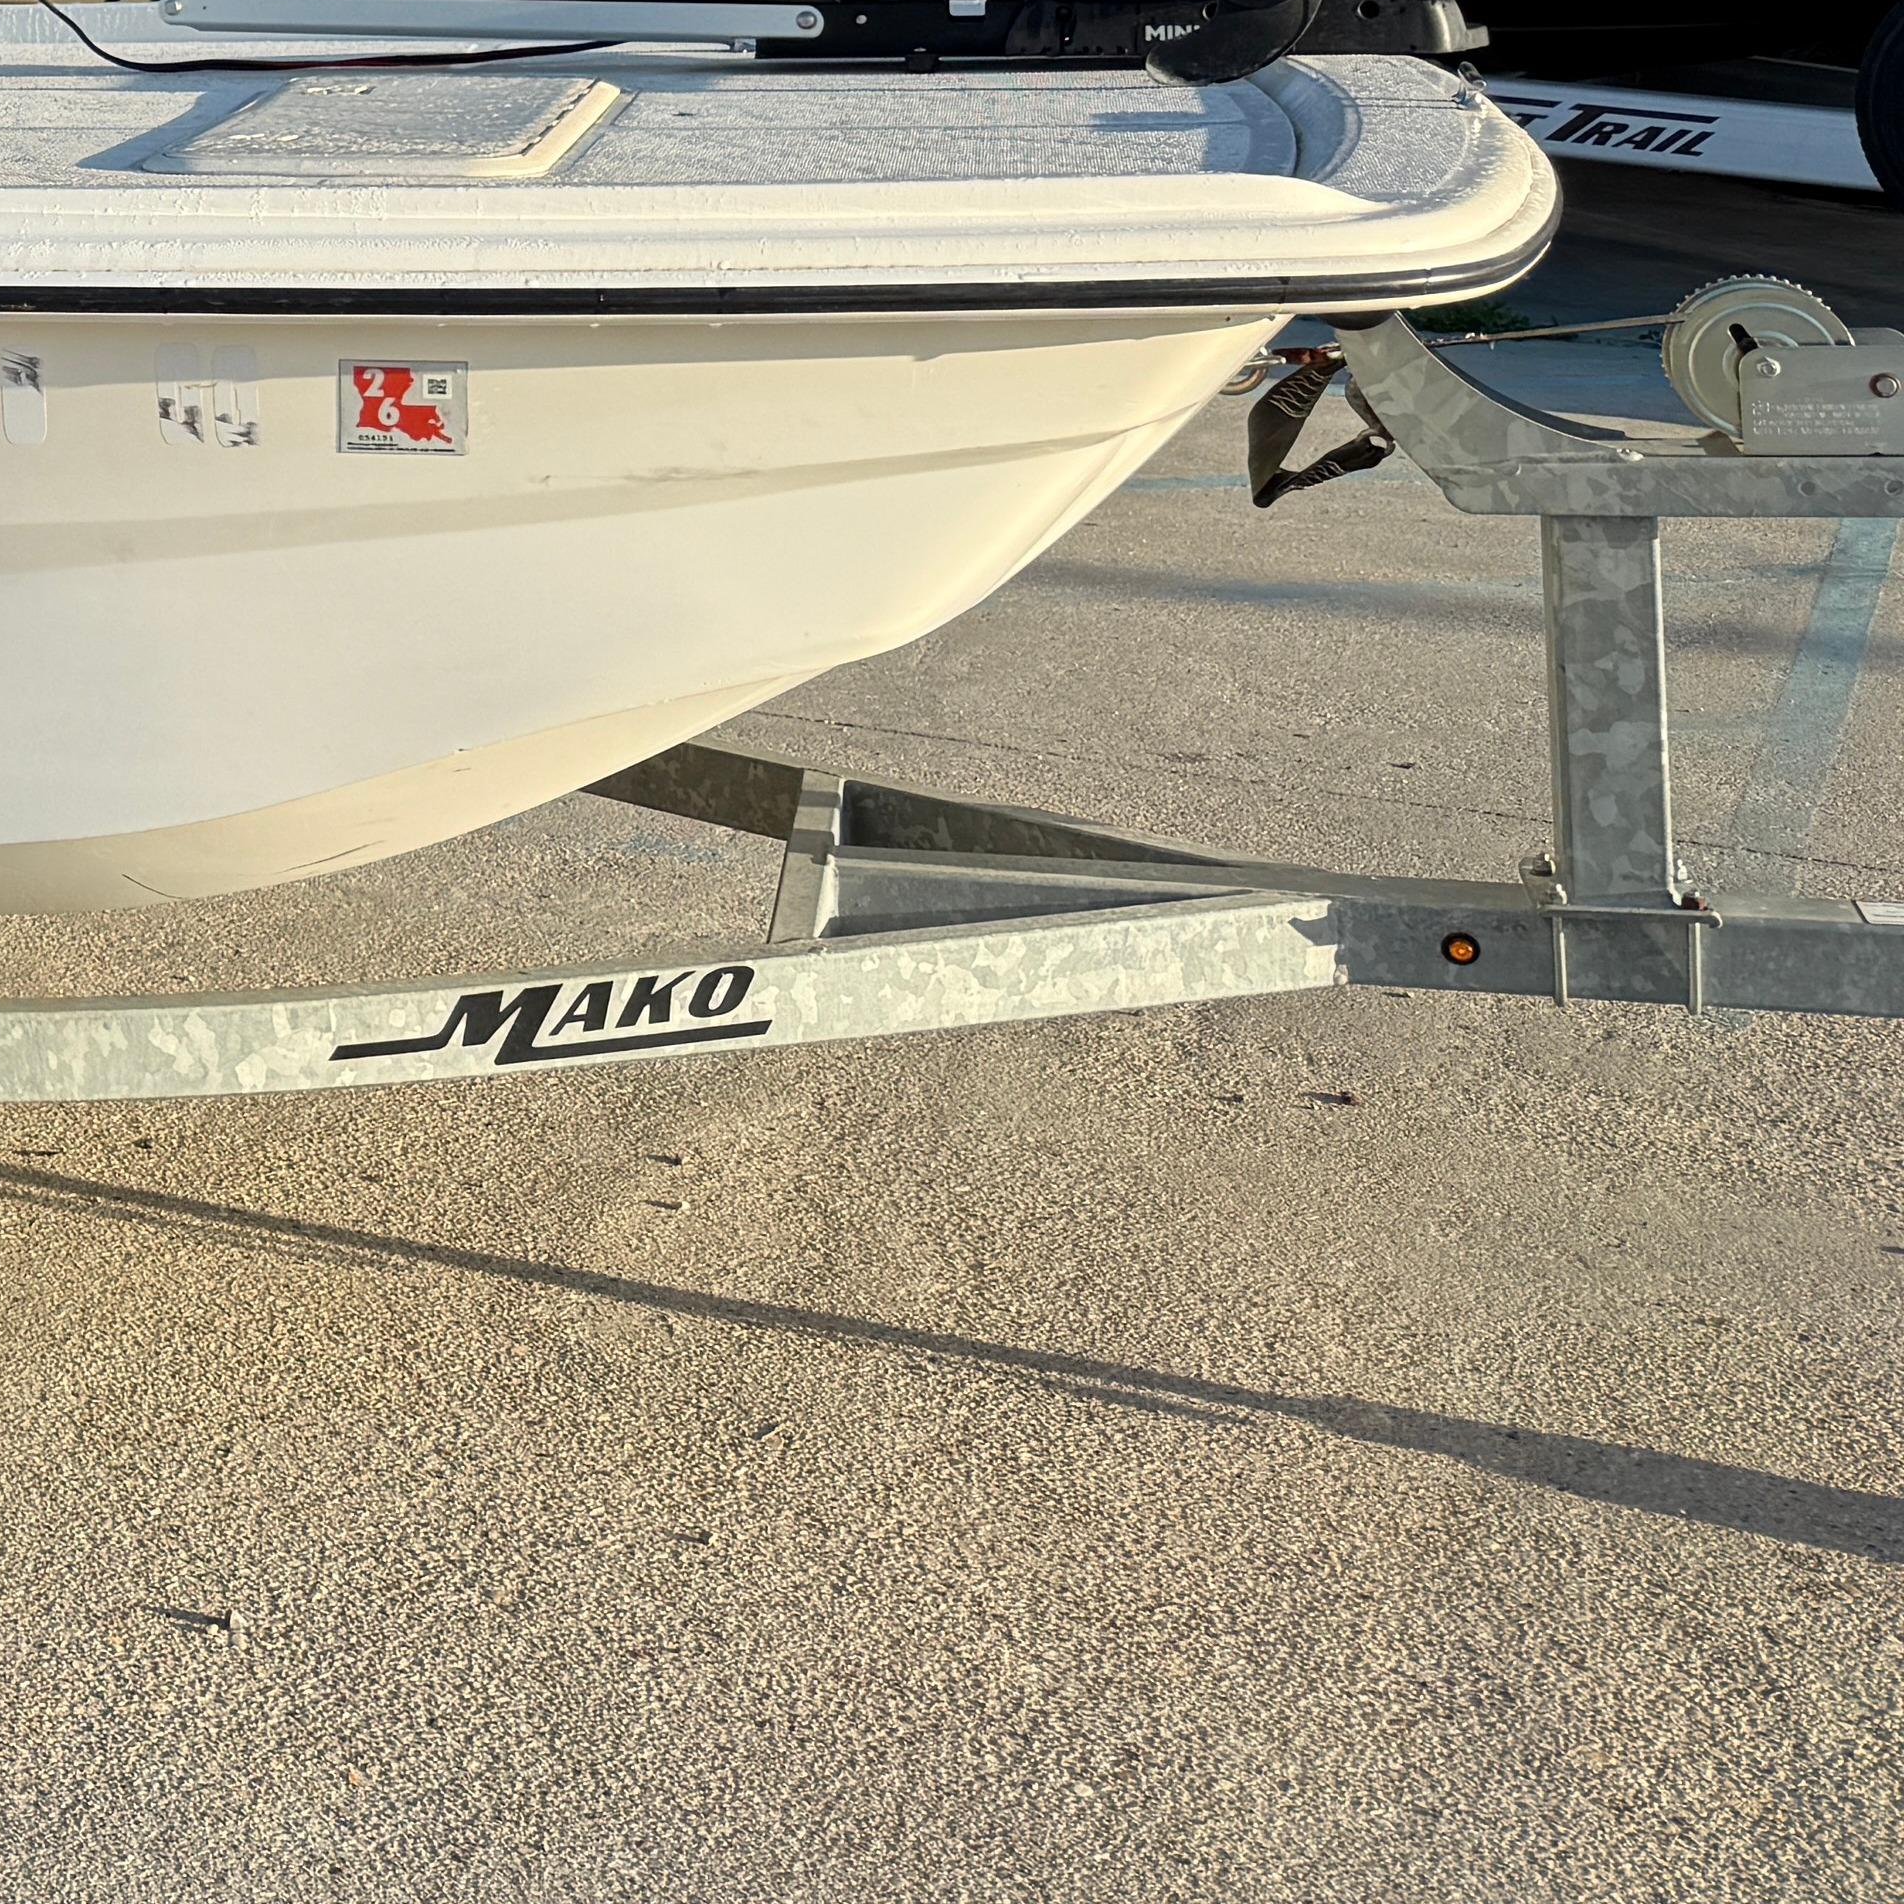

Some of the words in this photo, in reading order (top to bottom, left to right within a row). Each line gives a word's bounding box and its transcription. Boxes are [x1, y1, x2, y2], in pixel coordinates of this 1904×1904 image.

[1145, 25, 1200, 41] MIN
[1545, 103, 1721, 157] TRAIL
[422, 963, 764, 1065] MAKO
